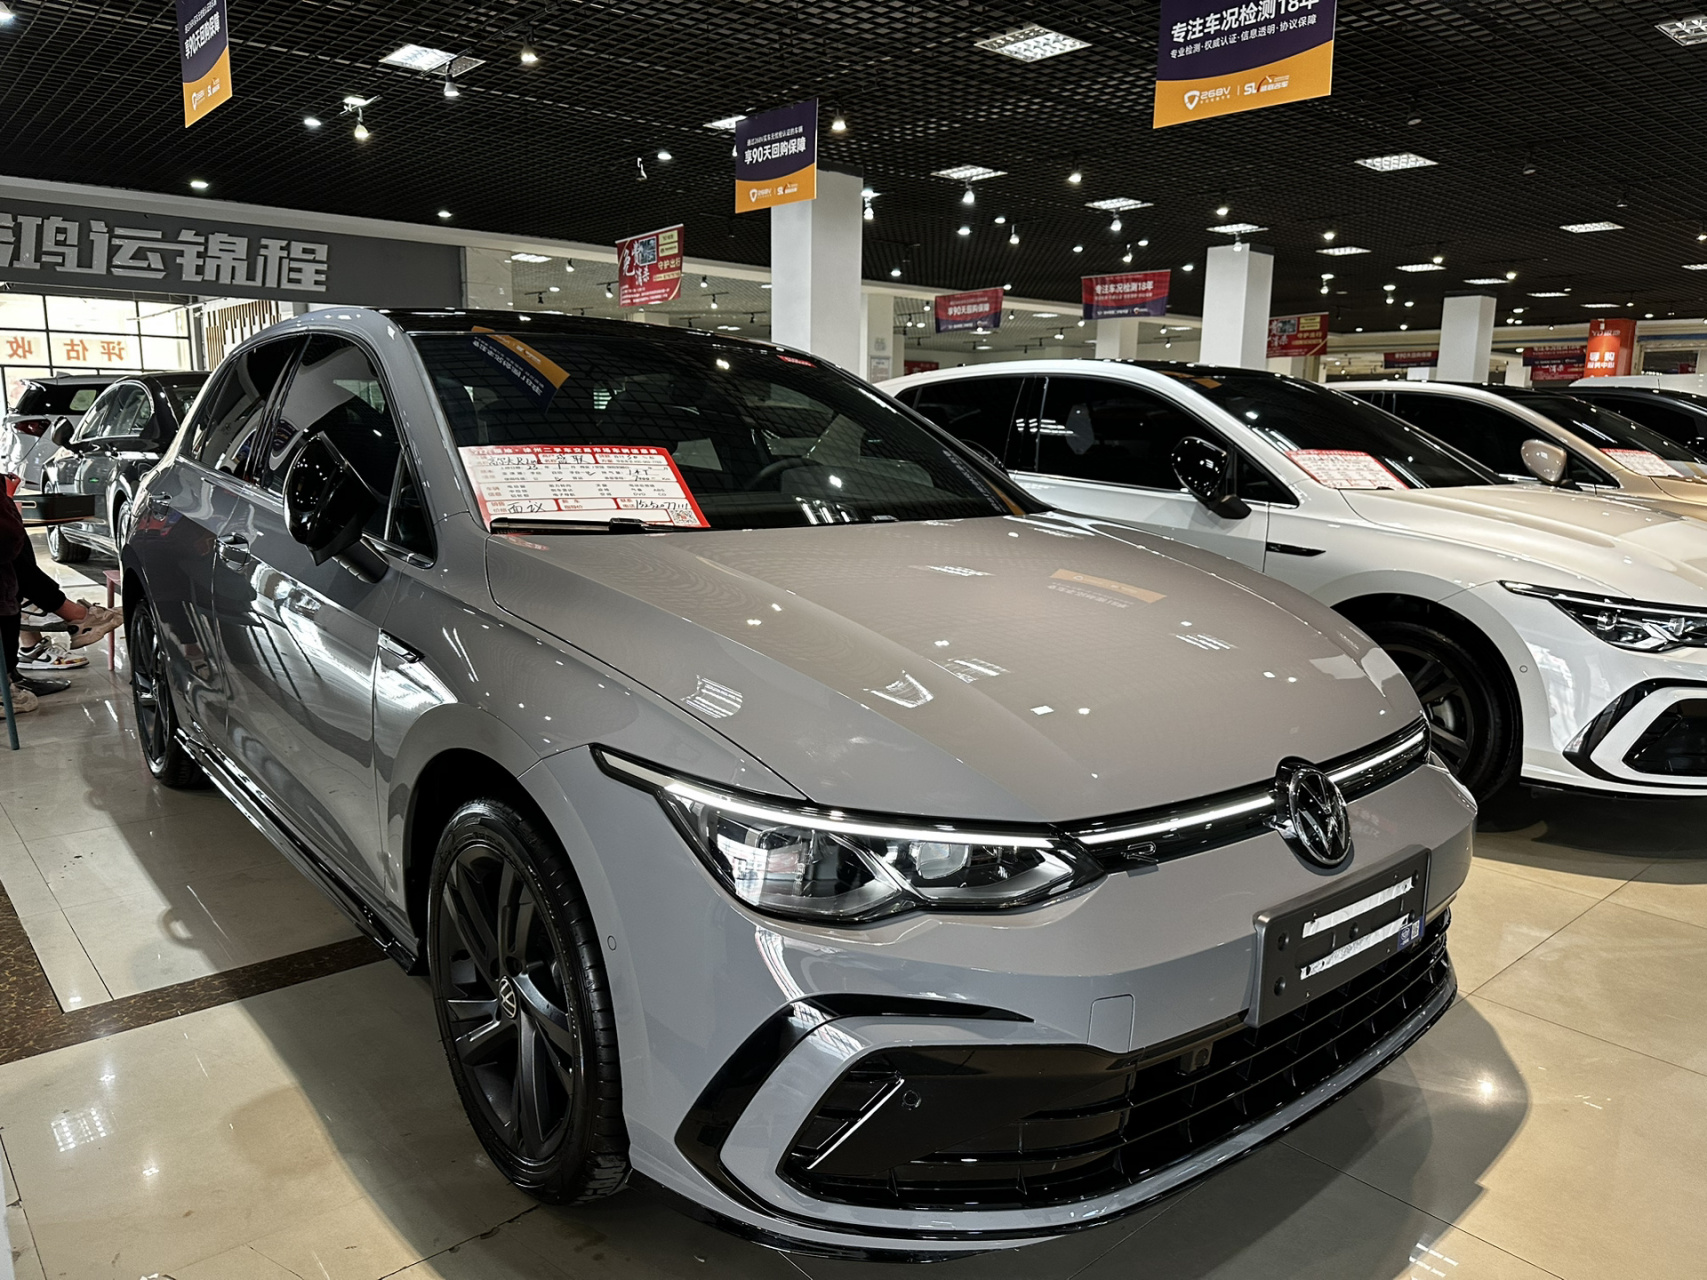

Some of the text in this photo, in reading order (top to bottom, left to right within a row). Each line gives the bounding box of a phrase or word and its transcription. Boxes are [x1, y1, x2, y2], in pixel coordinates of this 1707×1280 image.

[1200, 86, 1231, 99] 268V
[744, 136, 806, 165] 享90天回购保障
